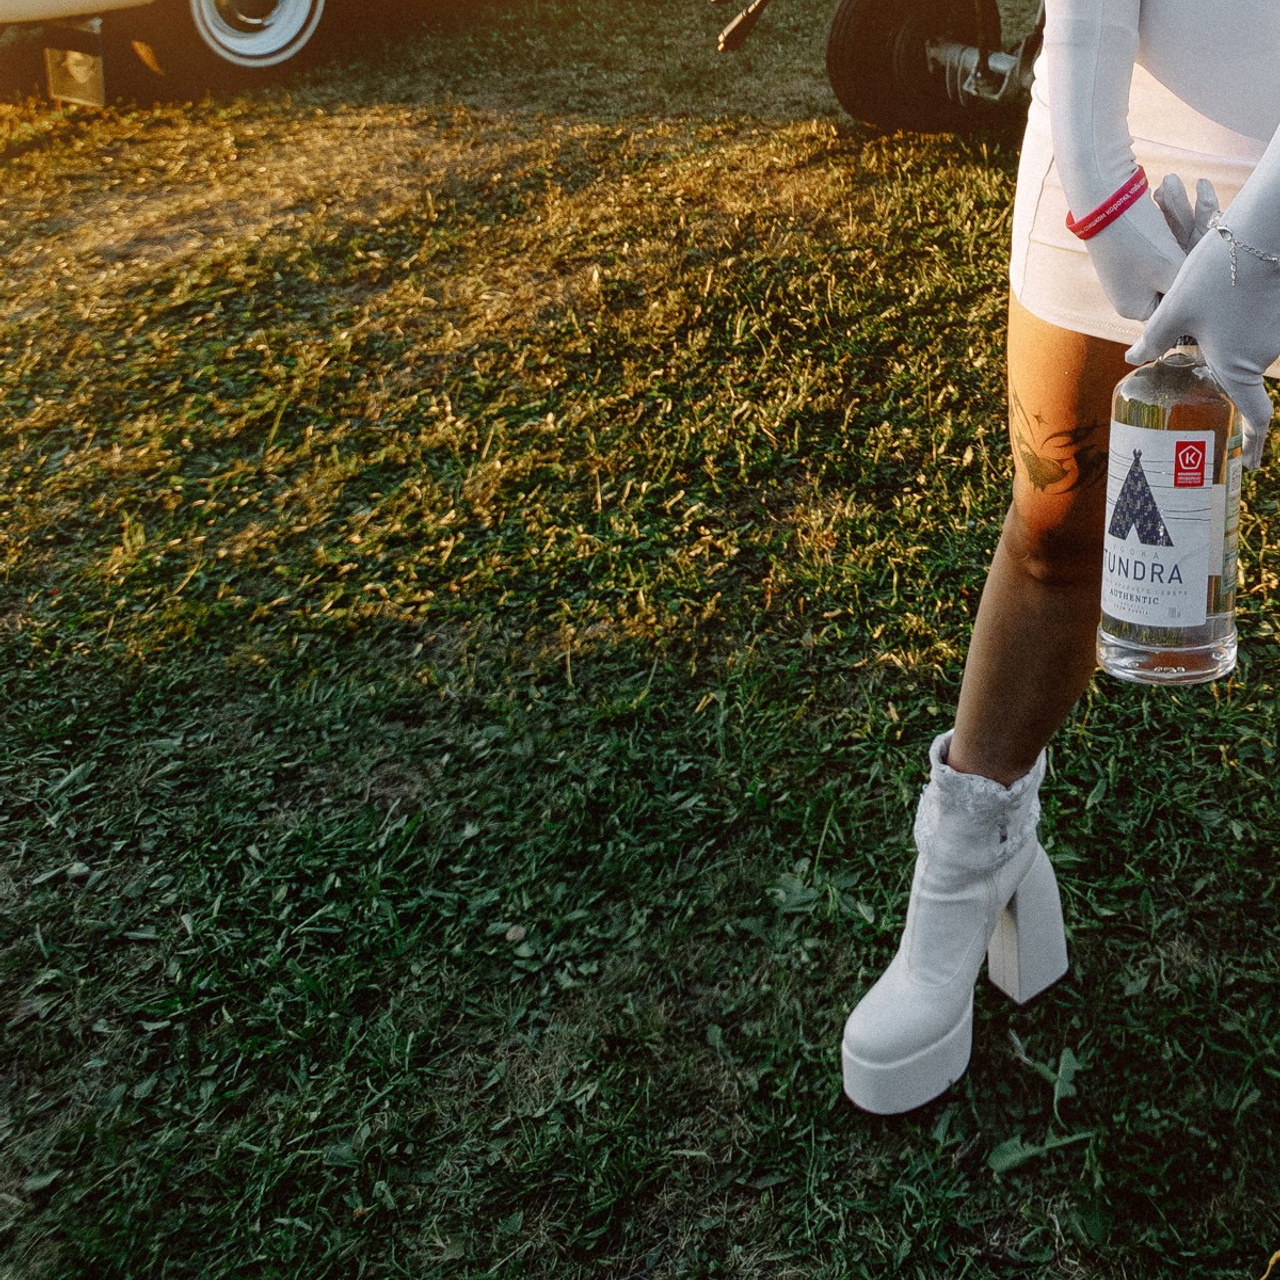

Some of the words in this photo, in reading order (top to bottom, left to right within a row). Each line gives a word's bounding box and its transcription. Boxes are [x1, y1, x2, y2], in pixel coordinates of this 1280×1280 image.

[1106, 192, 1132, 216] коротка,
[1109, 542, 1160, 560] VODKA
[1103, 548, 1184, 585] TUNDRA
[1109, 588, 1160, 606] AUTHENTIC
